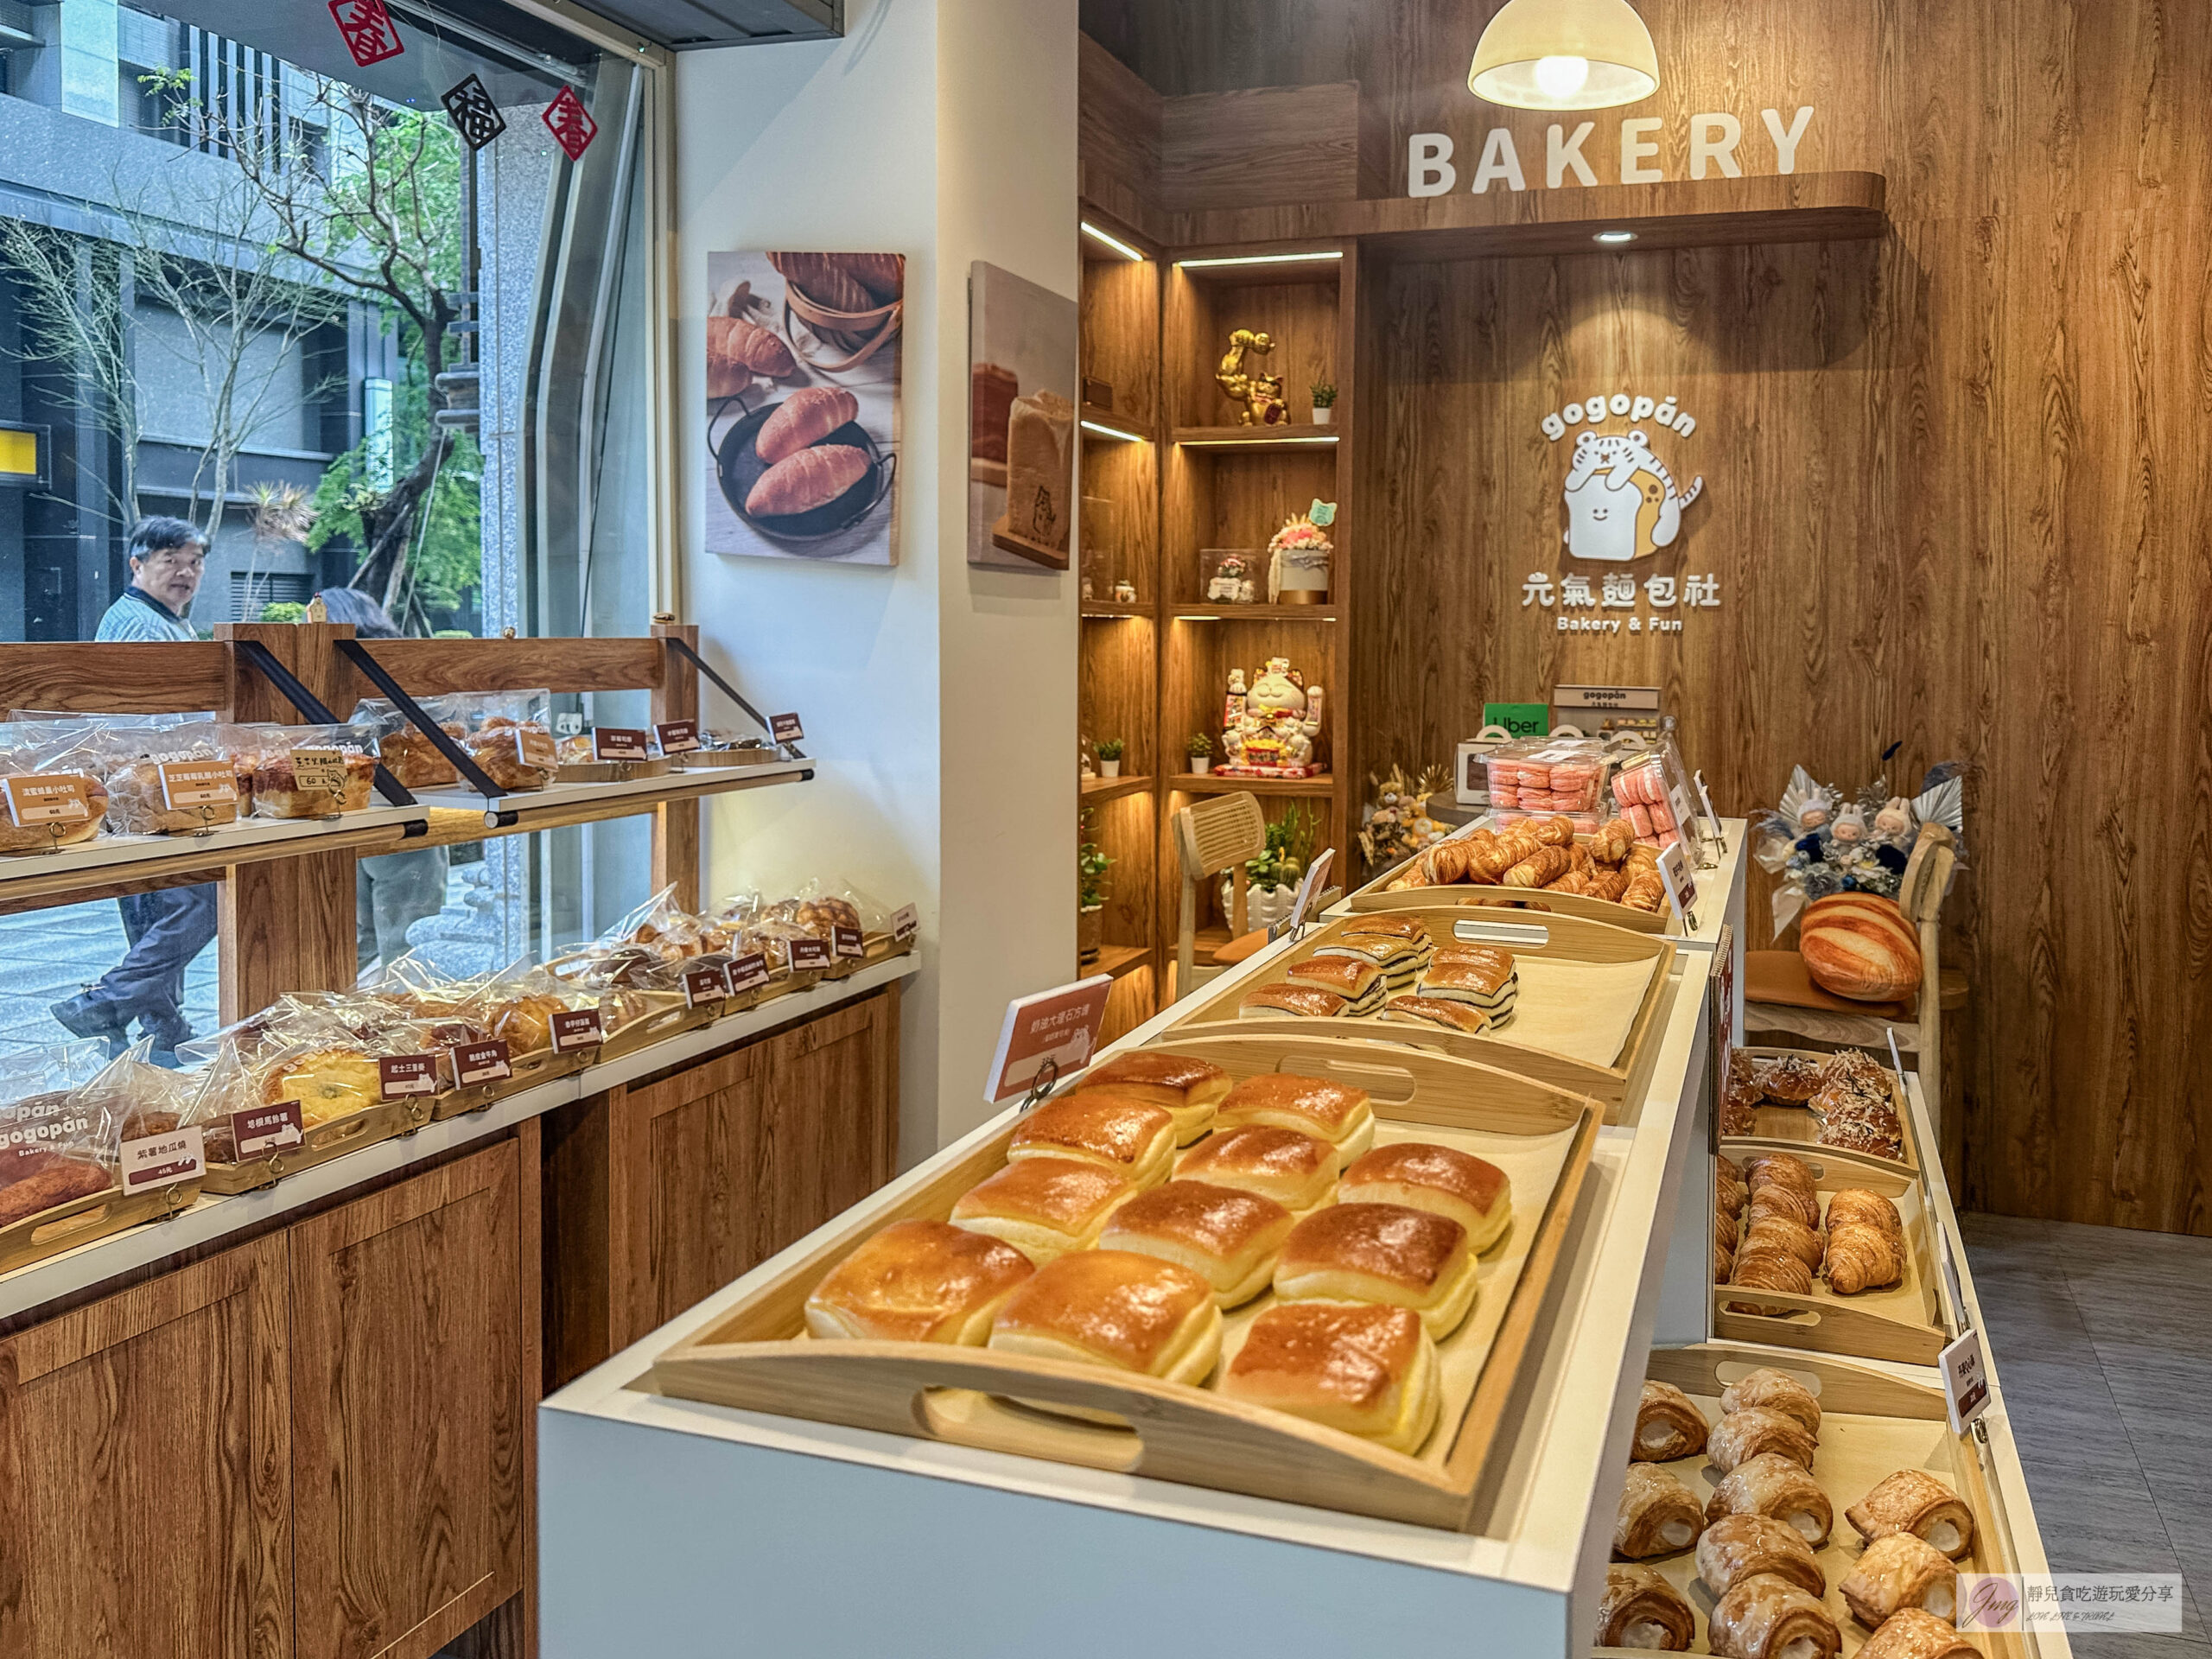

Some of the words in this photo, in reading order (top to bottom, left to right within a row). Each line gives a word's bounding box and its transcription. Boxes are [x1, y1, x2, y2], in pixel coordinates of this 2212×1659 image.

[1408, 105, 1815, 198] BAKERY
[1541, 394, 1696, 441] gogopán
[1557, 616, 1621, 632] Bakery
[1629, 617, 1641, 631] &
[1649, 617, 1682, 631] Fun
[137, 1140, 187, 1160] 紫薯地瓜燒
